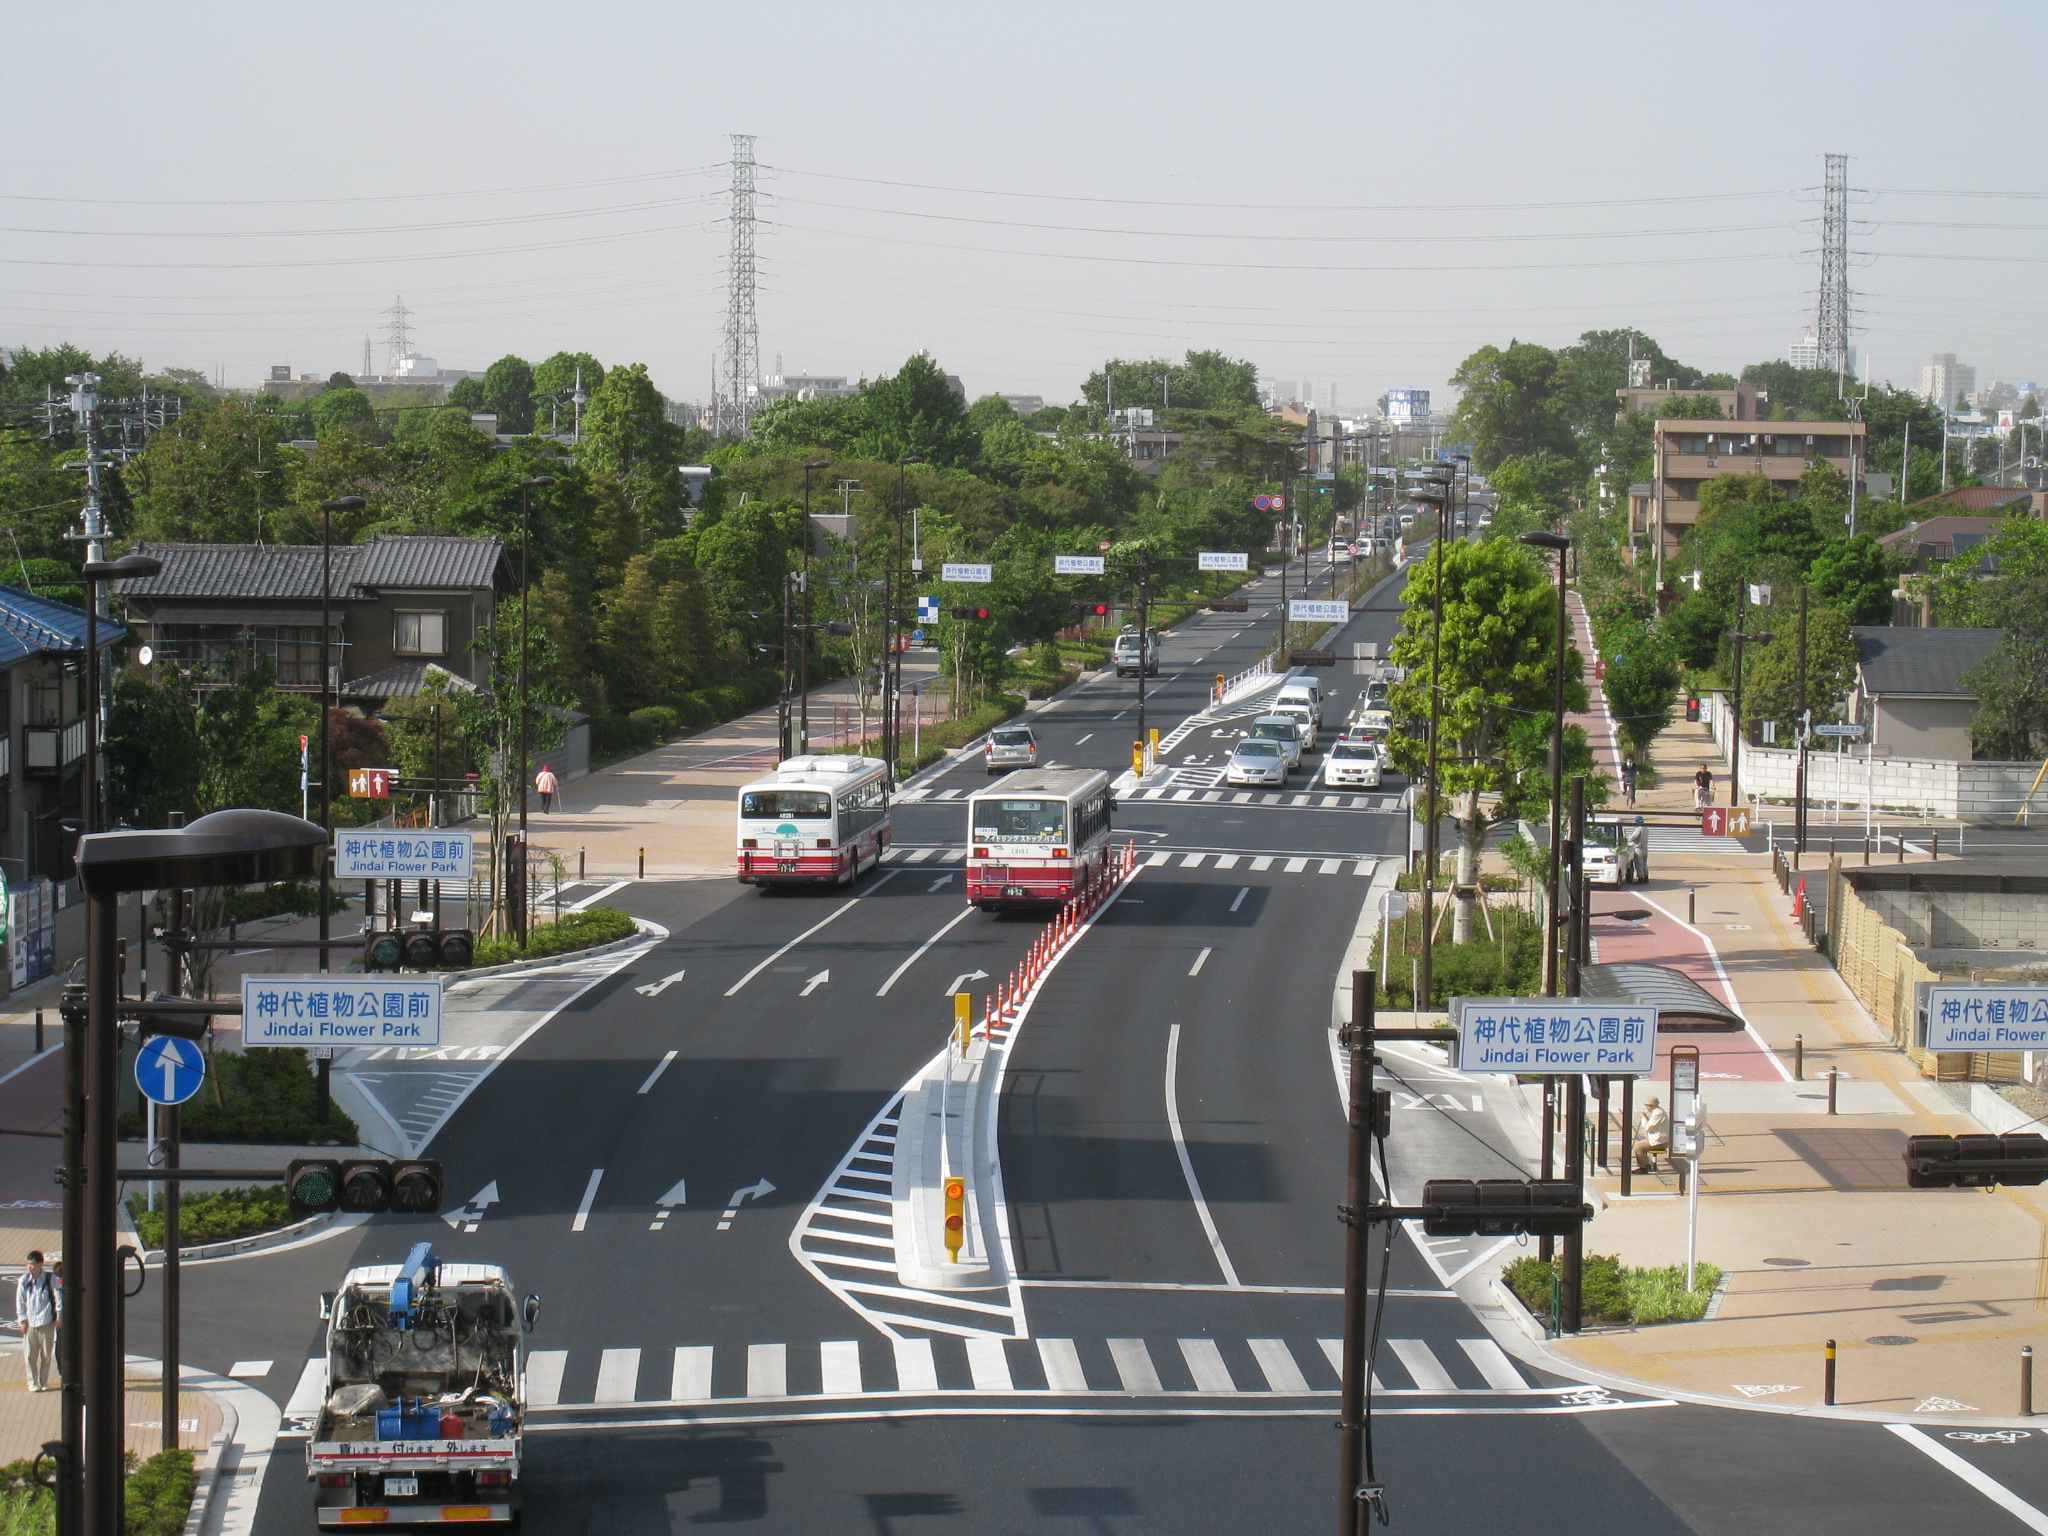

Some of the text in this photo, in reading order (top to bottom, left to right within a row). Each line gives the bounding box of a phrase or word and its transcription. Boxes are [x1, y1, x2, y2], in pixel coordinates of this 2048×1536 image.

[1293, 604, 1345, 613] 神代植物公園北
[345, 839, 464, 859] 神代植物公園前
[350, 861, 458, 872] Jindai Flower Park
[256, 991, 430, 1018] 神代植物公園前
[264, 1022, 420, 1037] Jindai Flower Park
[1474, 1016, 1645, 1044] 神代植物公園前
[1946, 1028, 2046, 1042] Jindai Flower
[1480, 1048, 1634, 1063] Jindai Flower Park
[339, 1441, 488, 1455] 貸します 付けます 外します
